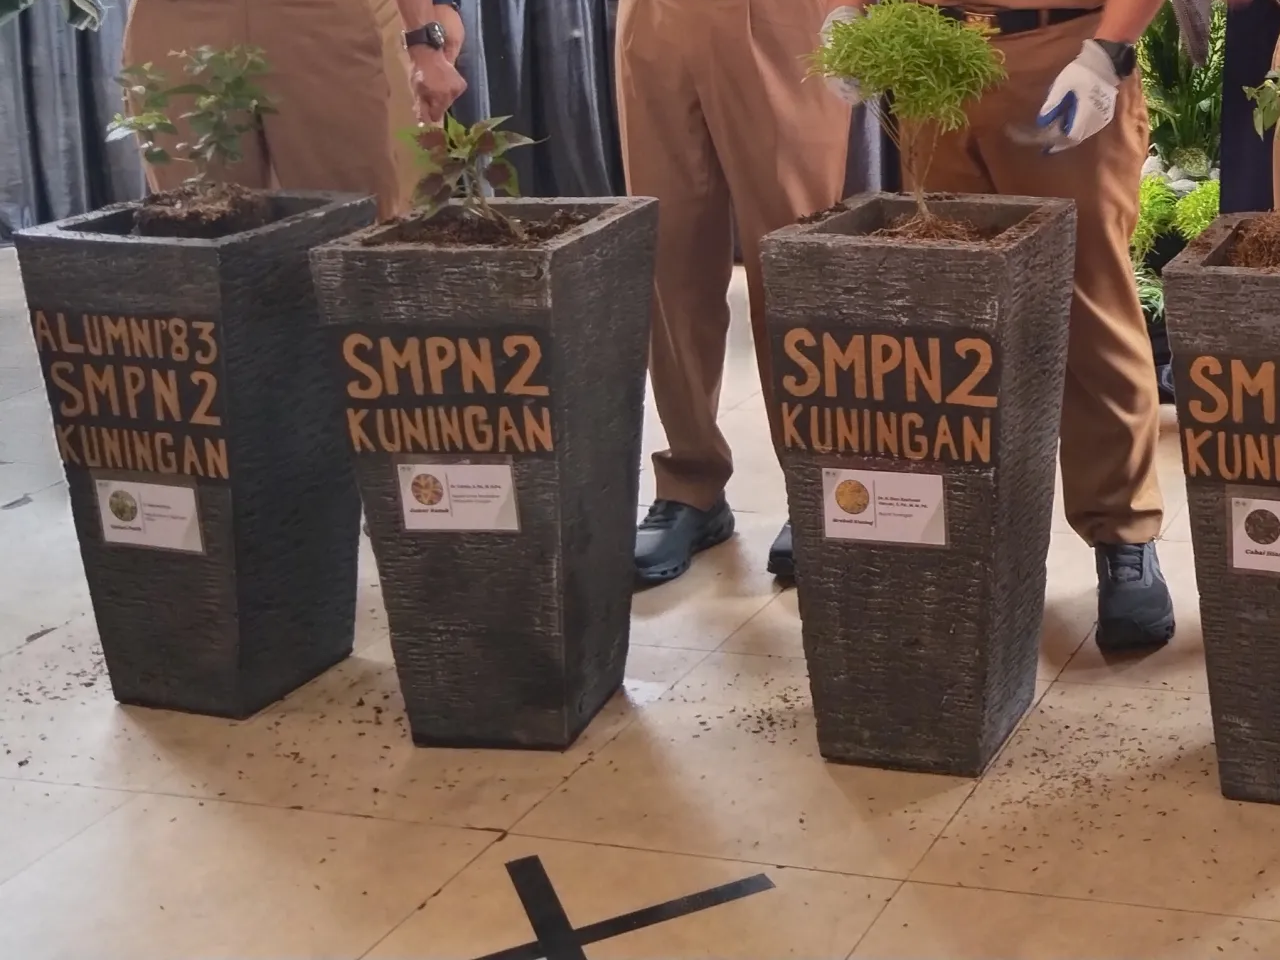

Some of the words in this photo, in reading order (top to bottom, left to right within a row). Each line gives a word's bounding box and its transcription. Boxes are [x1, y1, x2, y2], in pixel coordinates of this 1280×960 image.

[56, 424, 229, 479] KUNINGAN
[346, 405, 554, 453] KUNINGAN
[781, 401, 991, 463] KUNINGAN
